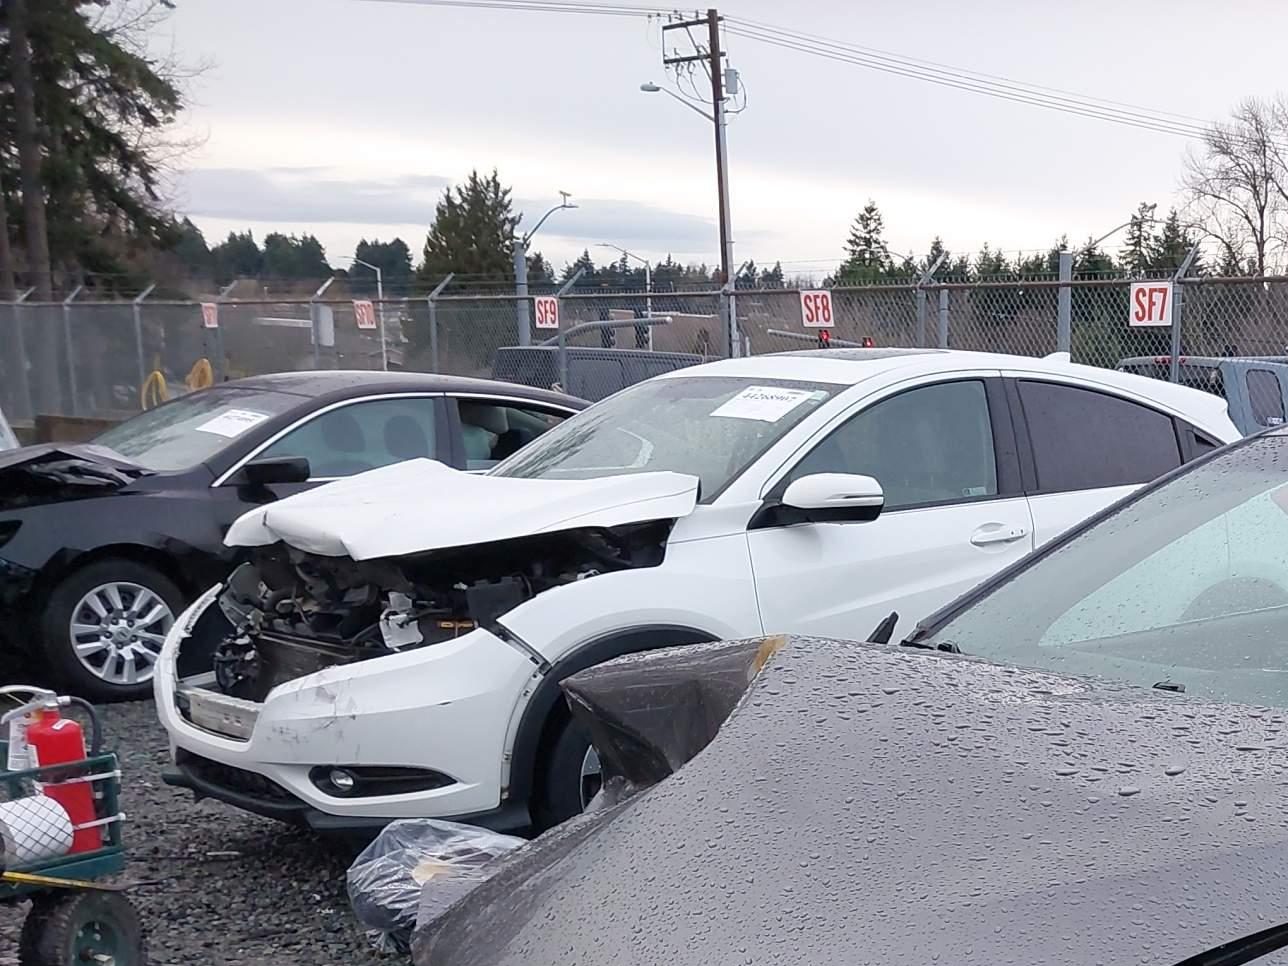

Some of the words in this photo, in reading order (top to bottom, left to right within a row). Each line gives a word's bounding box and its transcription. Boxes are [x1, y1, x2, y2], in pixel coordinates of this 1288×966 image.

[537, 299, 557, 325] SF9
[803, 294, 831, 323] SF8
[1134, 287, 1169, 322] SF7
